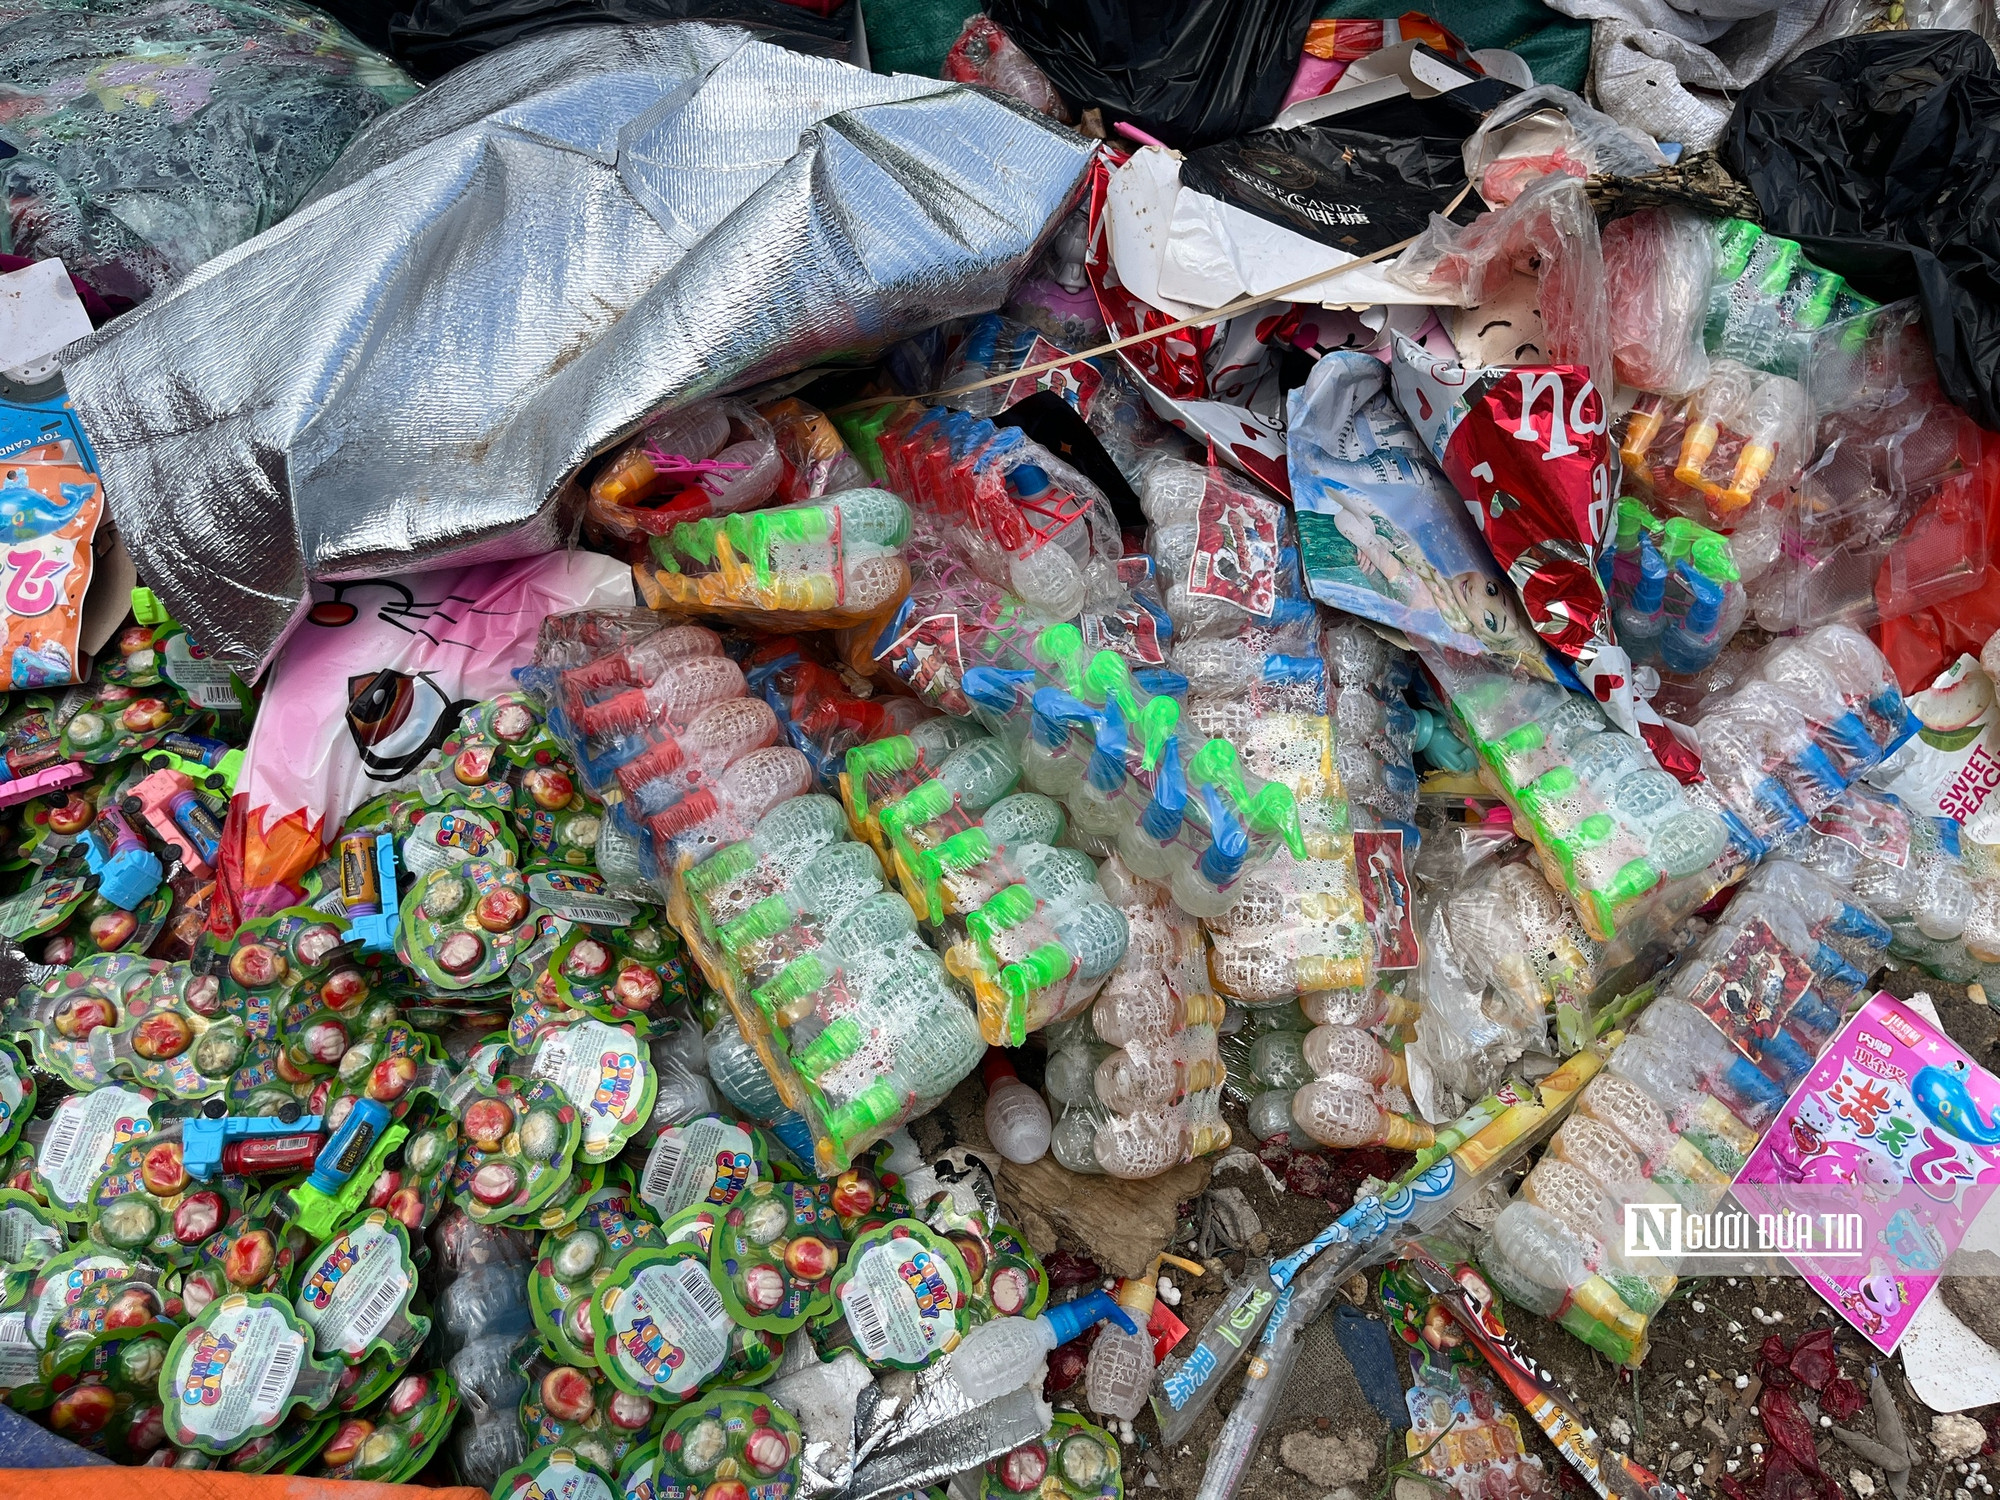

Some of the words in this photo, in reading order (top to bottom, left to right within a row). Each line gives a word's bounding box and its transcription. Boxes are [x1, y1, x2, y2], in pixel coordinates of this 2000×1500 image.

[1287, 193, 1362, 214] CANDY
[36, 431, 62, 444] TOY
[1936, 744, 1994, 817] SWEET
[436, 827, 489, 857] CANDY
[440, 814, 495, 844] GUMMY
[590, 1052, 621, 1117] CANDY
[608, 1053, 636, 1119] GUMMY
[1853, 1045, 1908, 1086] 现金奖
[343, 1149, 358, 1168] FUEL
[352, 1133, 364, 1150] TANK
[723, 1152, 751, 1204] GUMM
[68, 1268, 129, 1289] GUMM
[303, 1237, 351, 1302] GUMMY
[313, 1245, 360, 1310] CANDY
[898, 1261, 940, 1319] CANDY
[913, 1252, 953, 1311] GUMMY
[183, 1332, 219, 1405] GUMMY
[619, 1329, 673, 1383] GUMMY
[631, 1315, 685, 1368] CANDY
[201, 1334, 237, 1406] CANDY
[1163, 1341, 1218, 1411] 果冻
[750, 1482, 790, 1498] GUMMY
